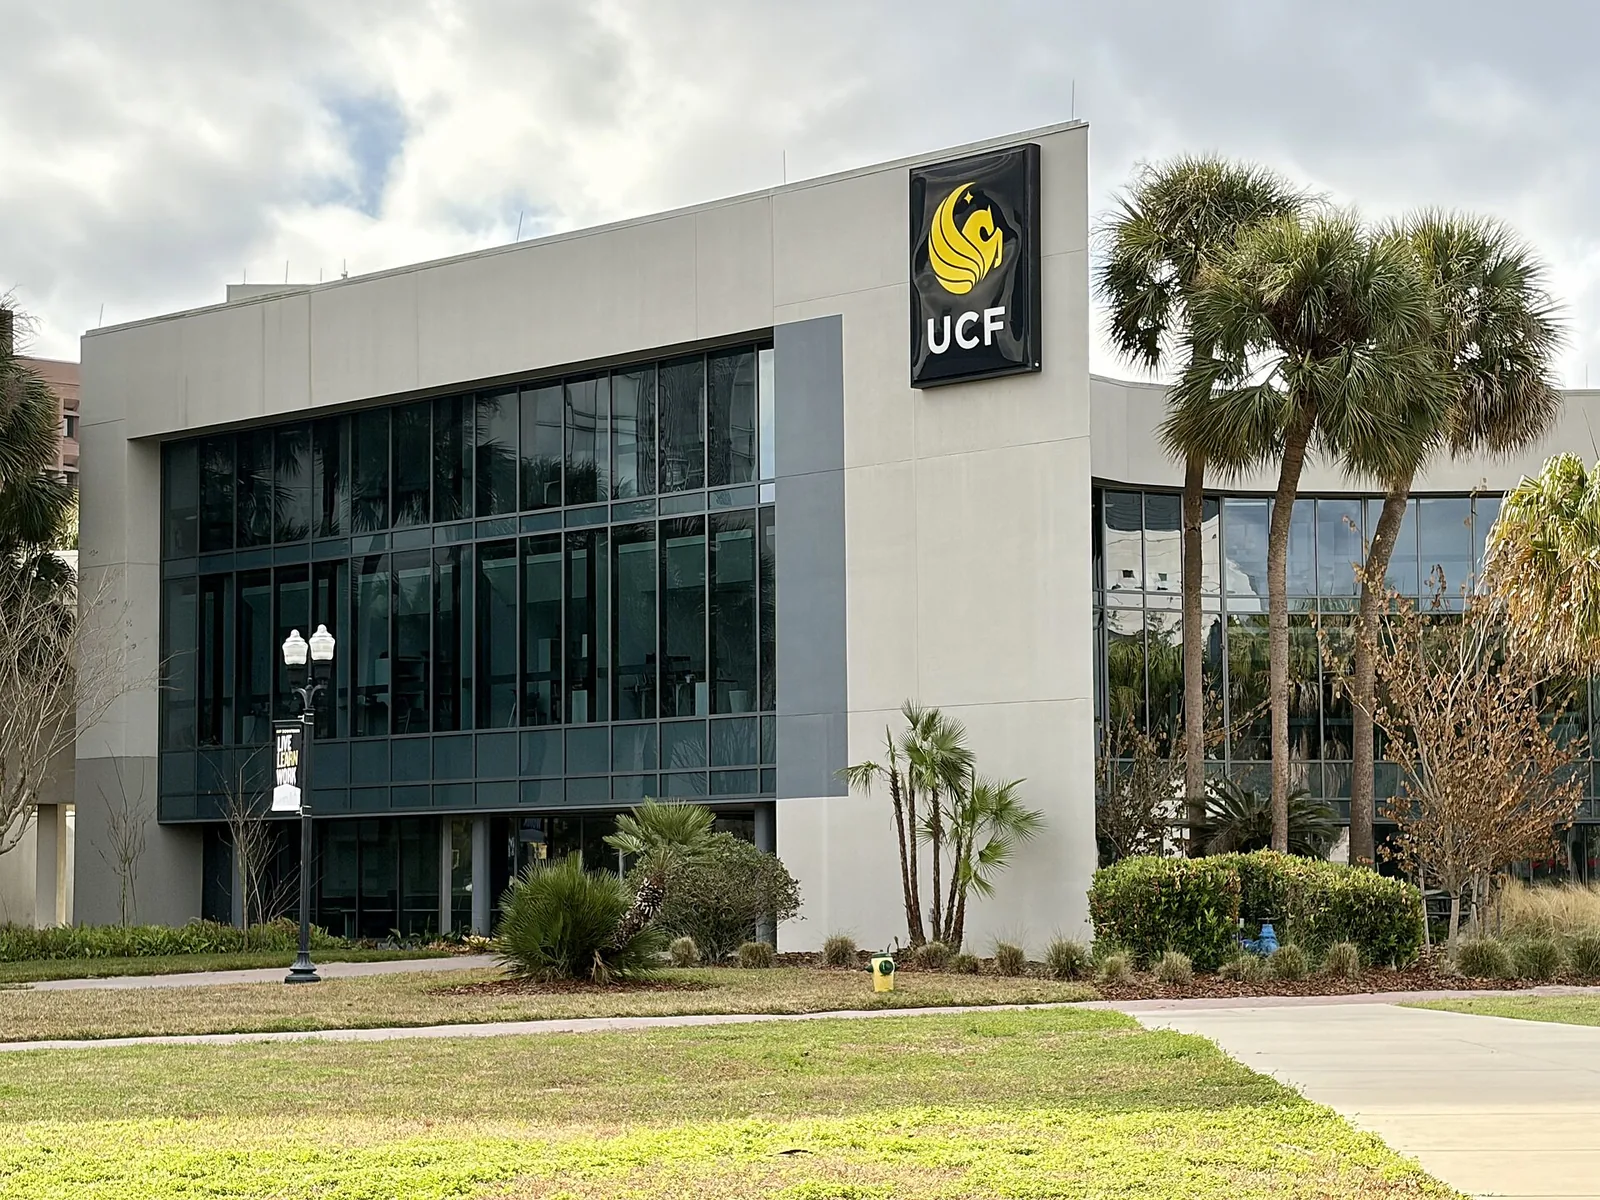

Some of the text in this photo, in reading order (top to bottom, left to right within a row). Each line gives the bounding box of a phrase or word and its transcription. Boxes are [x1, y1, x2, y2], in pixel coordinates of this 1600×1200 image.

[927, 306, 1006, 354] UCF
[277, 735, 292, 751] LIVE
[277, 750, 298, 768] LEARN
[276, 767, 297, 786] WORK
